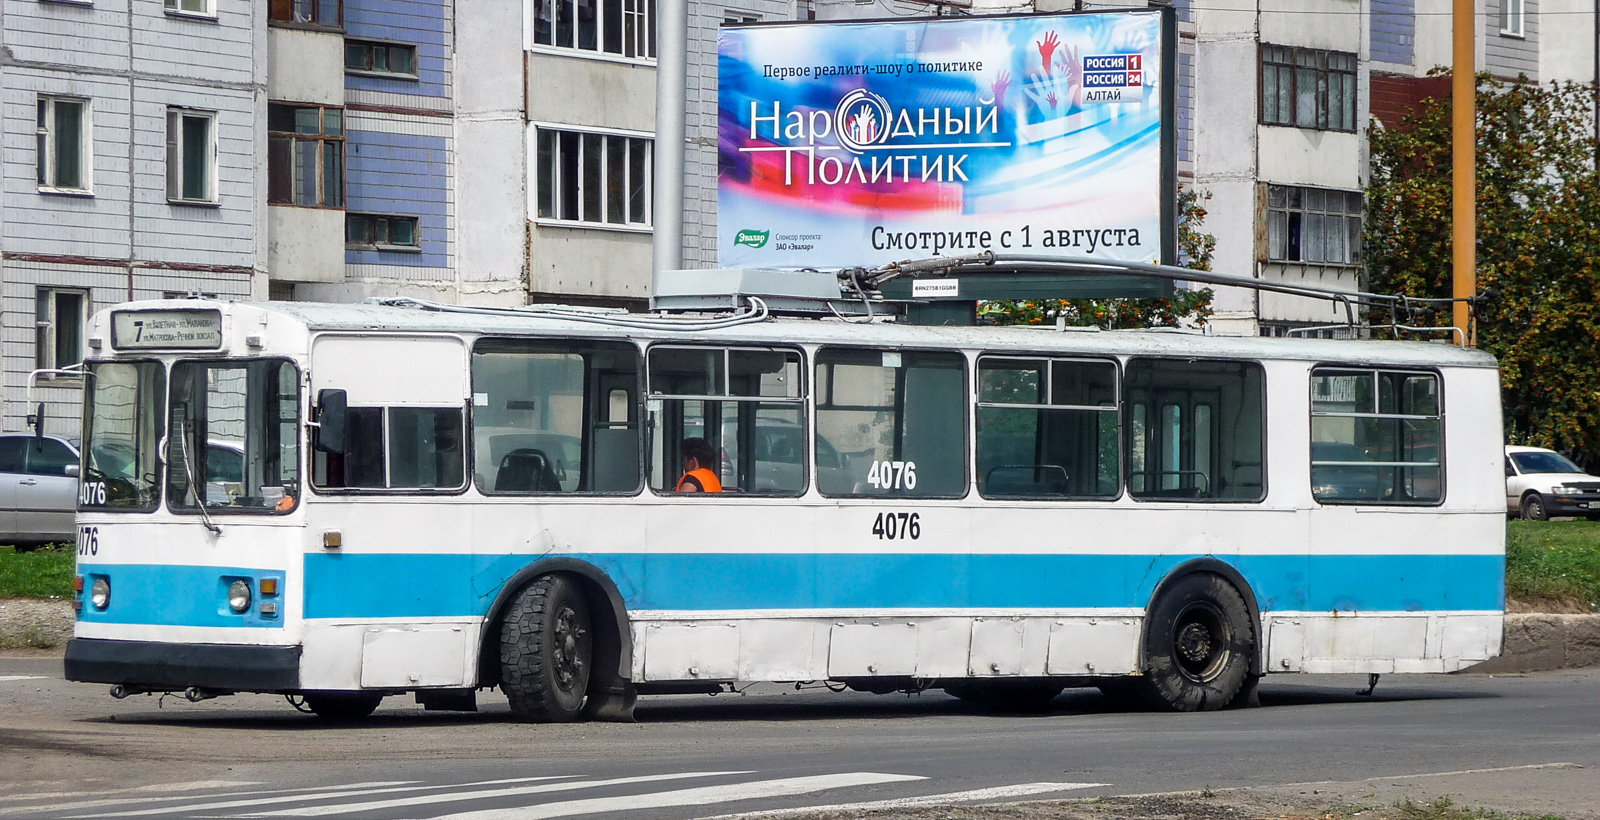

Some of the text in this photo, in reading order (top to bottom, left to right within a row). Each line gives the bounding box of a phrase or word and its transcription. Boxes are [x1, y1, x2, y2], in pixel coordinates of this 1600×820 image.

[763, 61, 983, 80] Первое реалити-шоу о политике
[1086, 56, 1138, 69] РОССИЯ 1
[1086, 74, 1141, 85] РОССИЯ 24
[1086, 88, 1121, 101] АЛТАЙ
[784, 146, 970, 186] Политик
[738, 232, 765, 244] Эвалар
[775, 233, 798, 242] Спонсор
[775, 243, 787, 251] ЗАО
[871, 225, 1141, 255] Смотрите с 1 августа
[134, 321, 144, 342] 7
[867, 460, 917, 490] 4076
[872, 512, 921, 540] 4076
[77, 526, 99, 556] 076
